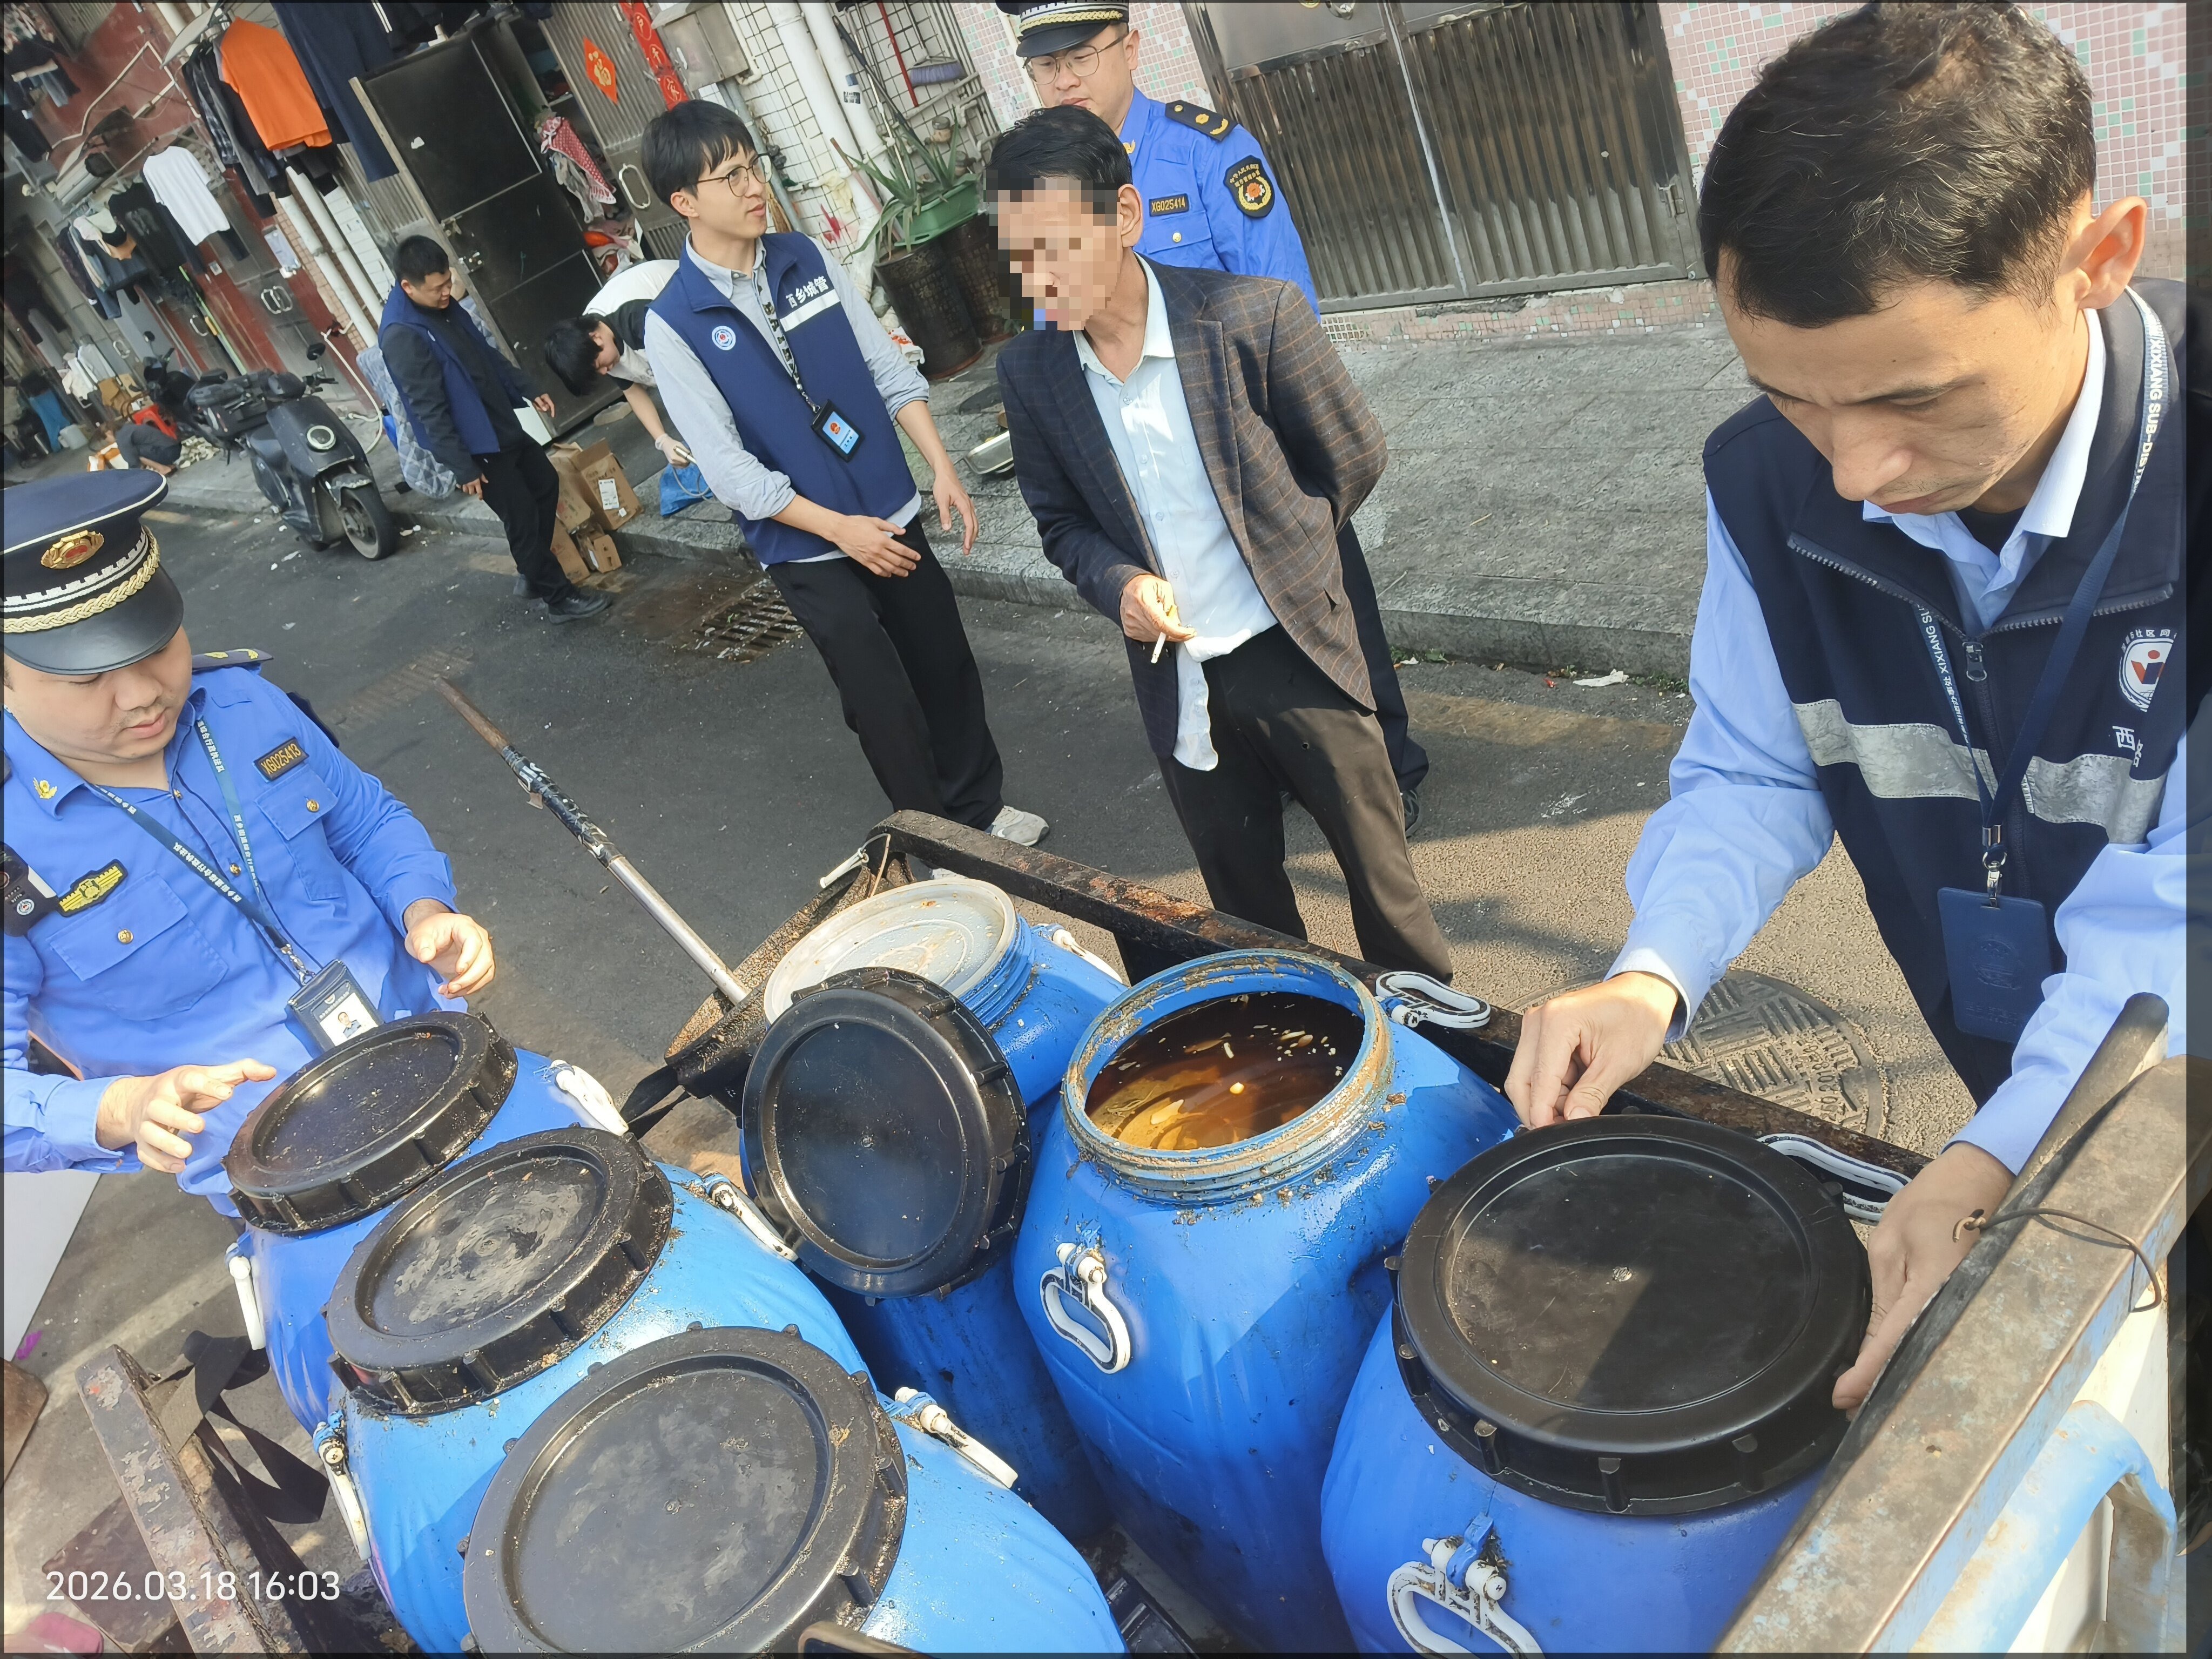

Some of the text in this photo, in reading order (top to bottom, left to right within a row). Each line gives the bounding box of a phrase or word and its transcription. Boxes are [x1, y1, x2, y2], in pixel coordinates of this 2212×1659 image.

[1151, 195, 1185, 213] XG025414
[785, 275, 829, 308] 西乡城管
[2149, 339, 2163, 401] XIXIANG
[1925, 625, 1949, 674] XIXIANG
[260, 743, 301, 775] XG025413
